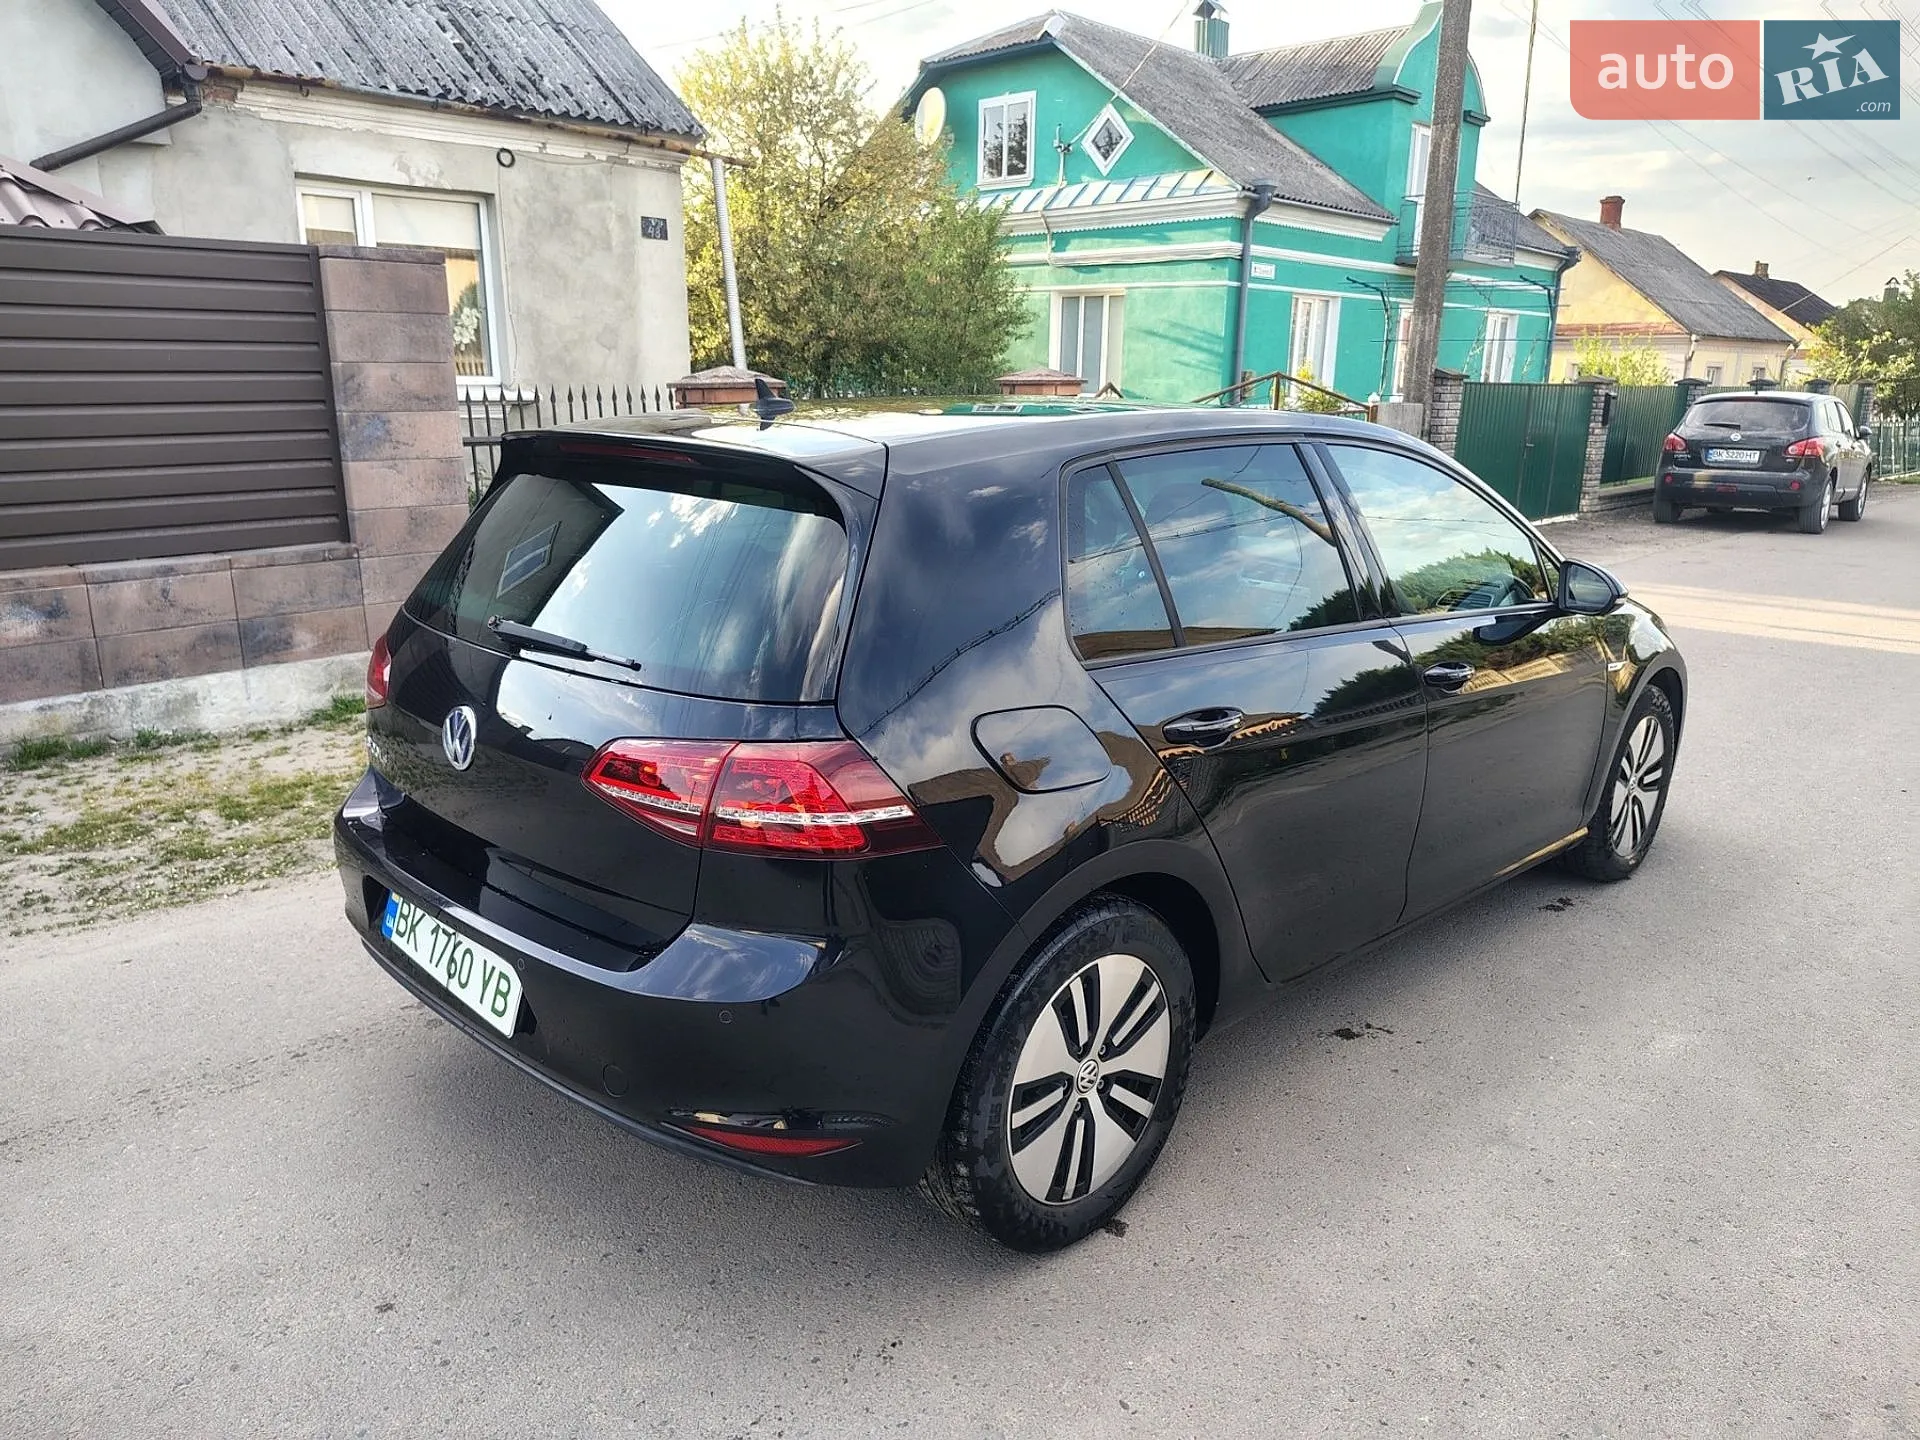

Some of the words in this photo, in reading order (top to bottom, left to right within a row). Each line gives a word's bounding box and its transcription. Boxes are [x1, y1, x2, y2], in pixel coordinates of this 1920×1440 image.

[395, 900, 427, 952] BK
[429, 923, 475, 989] 1760
[479, 959, 512, 1018] YB
